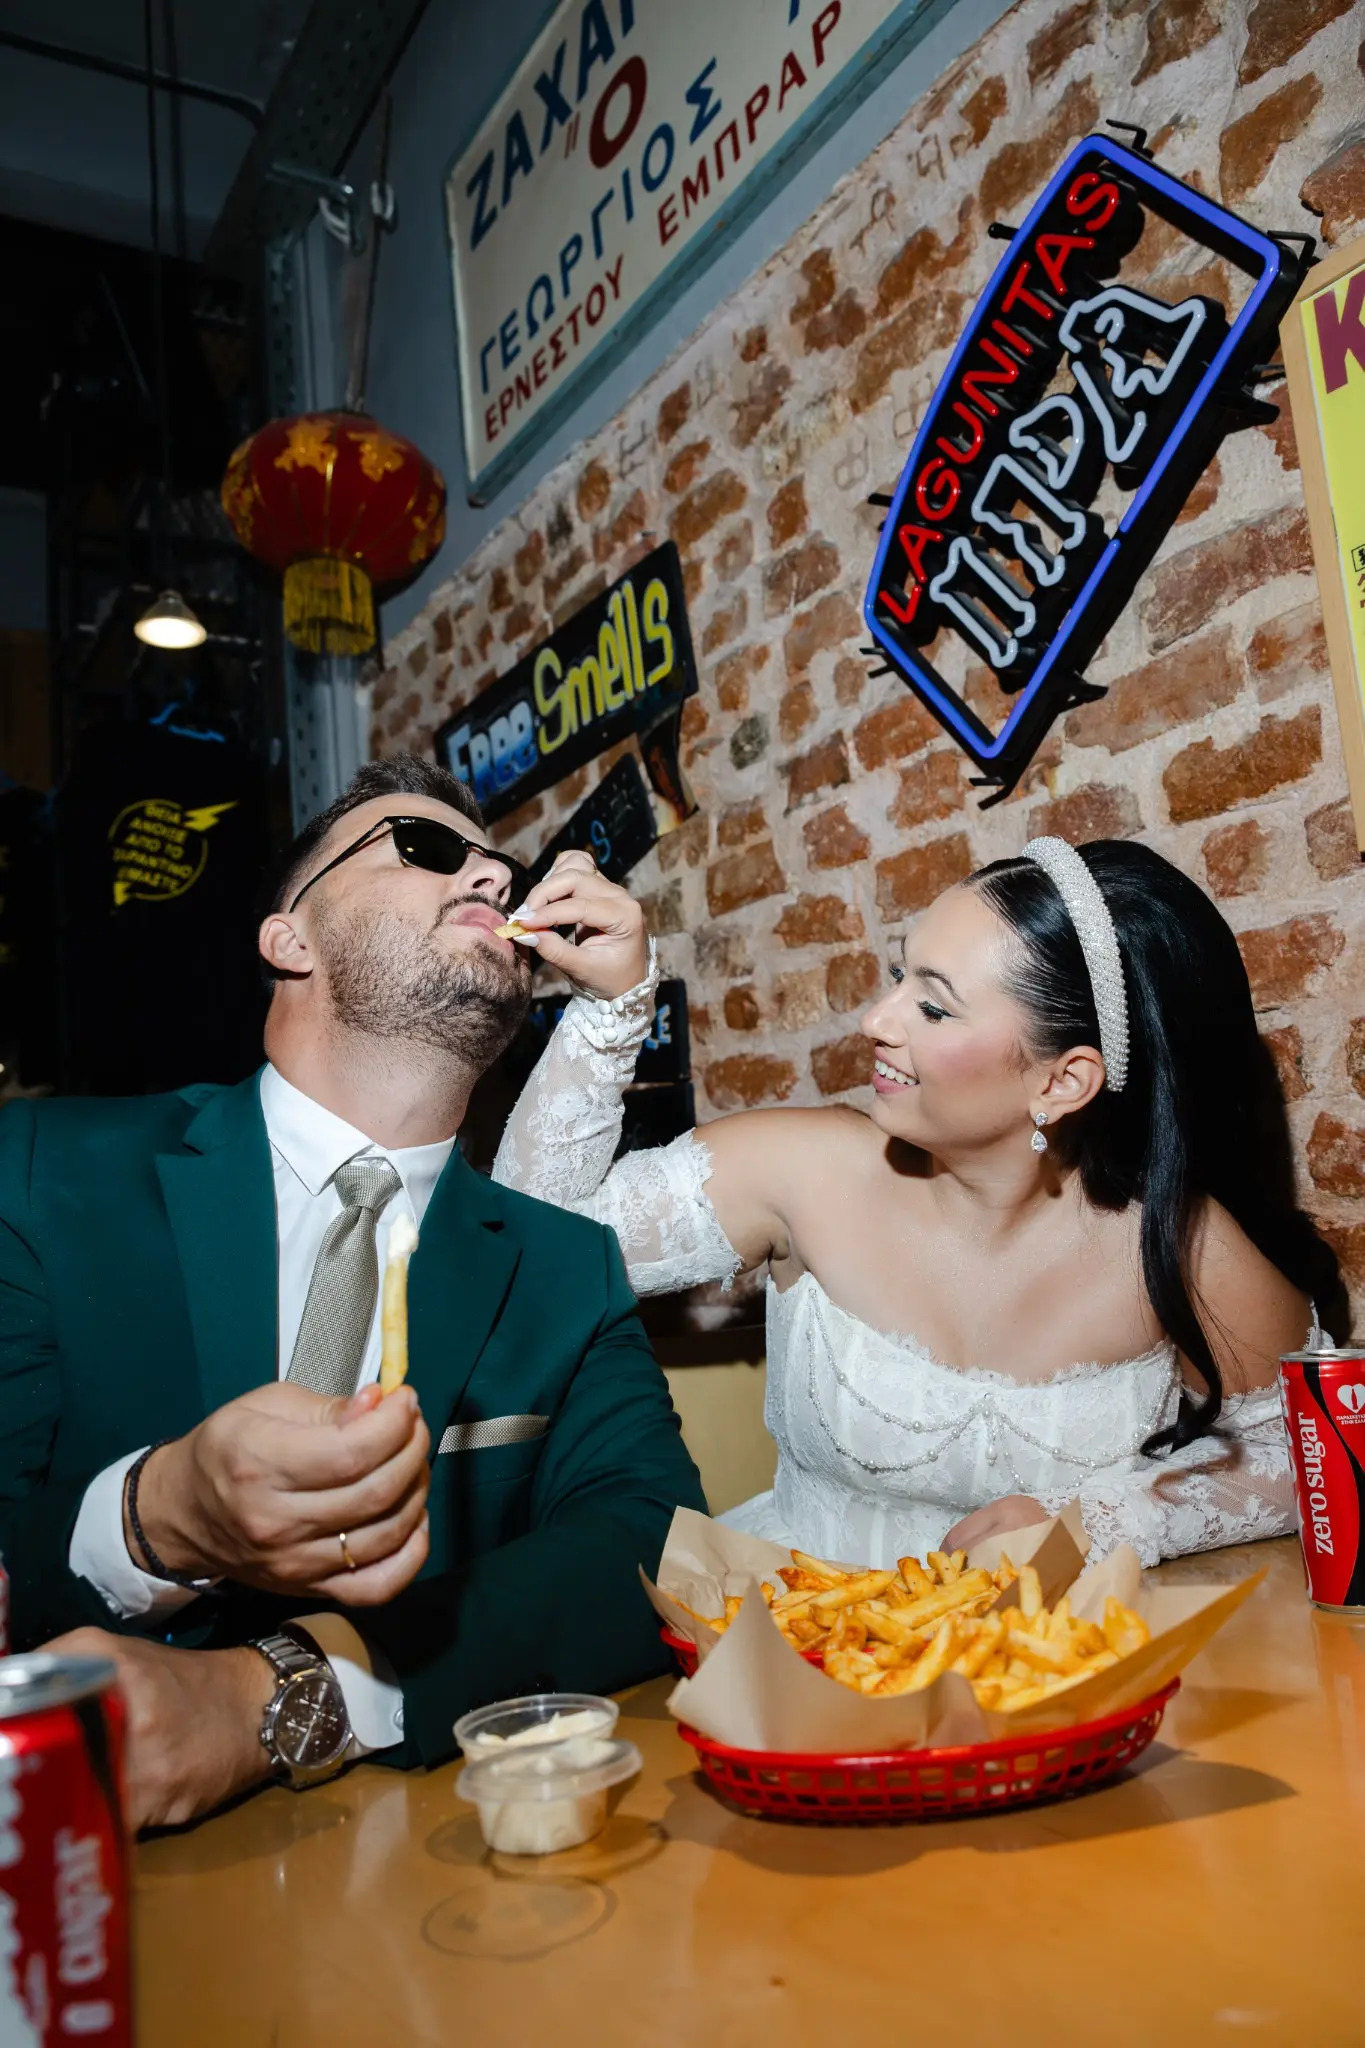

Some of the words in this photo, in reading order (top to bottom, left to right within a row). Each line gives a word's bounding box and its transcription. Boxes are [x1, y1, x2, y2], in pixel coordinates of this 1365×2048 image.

[479, 57, 722, 395] ΓΕΩΡΓΙΟΣ
[484, 255, 624, 443] ΕΡΝΕΣΤΟΥ
[657, 0, 842, 247] ΕΜΠΡΑΡ
[879, 171, 1120, 624] LAGUNITAS
[929, 284, 1206, 668] IPA
[533, 577, 675, 756] Smells
[1298, 1412, 1326, 1489] sugar
[1308, 1492, 1334, 1556] zero
